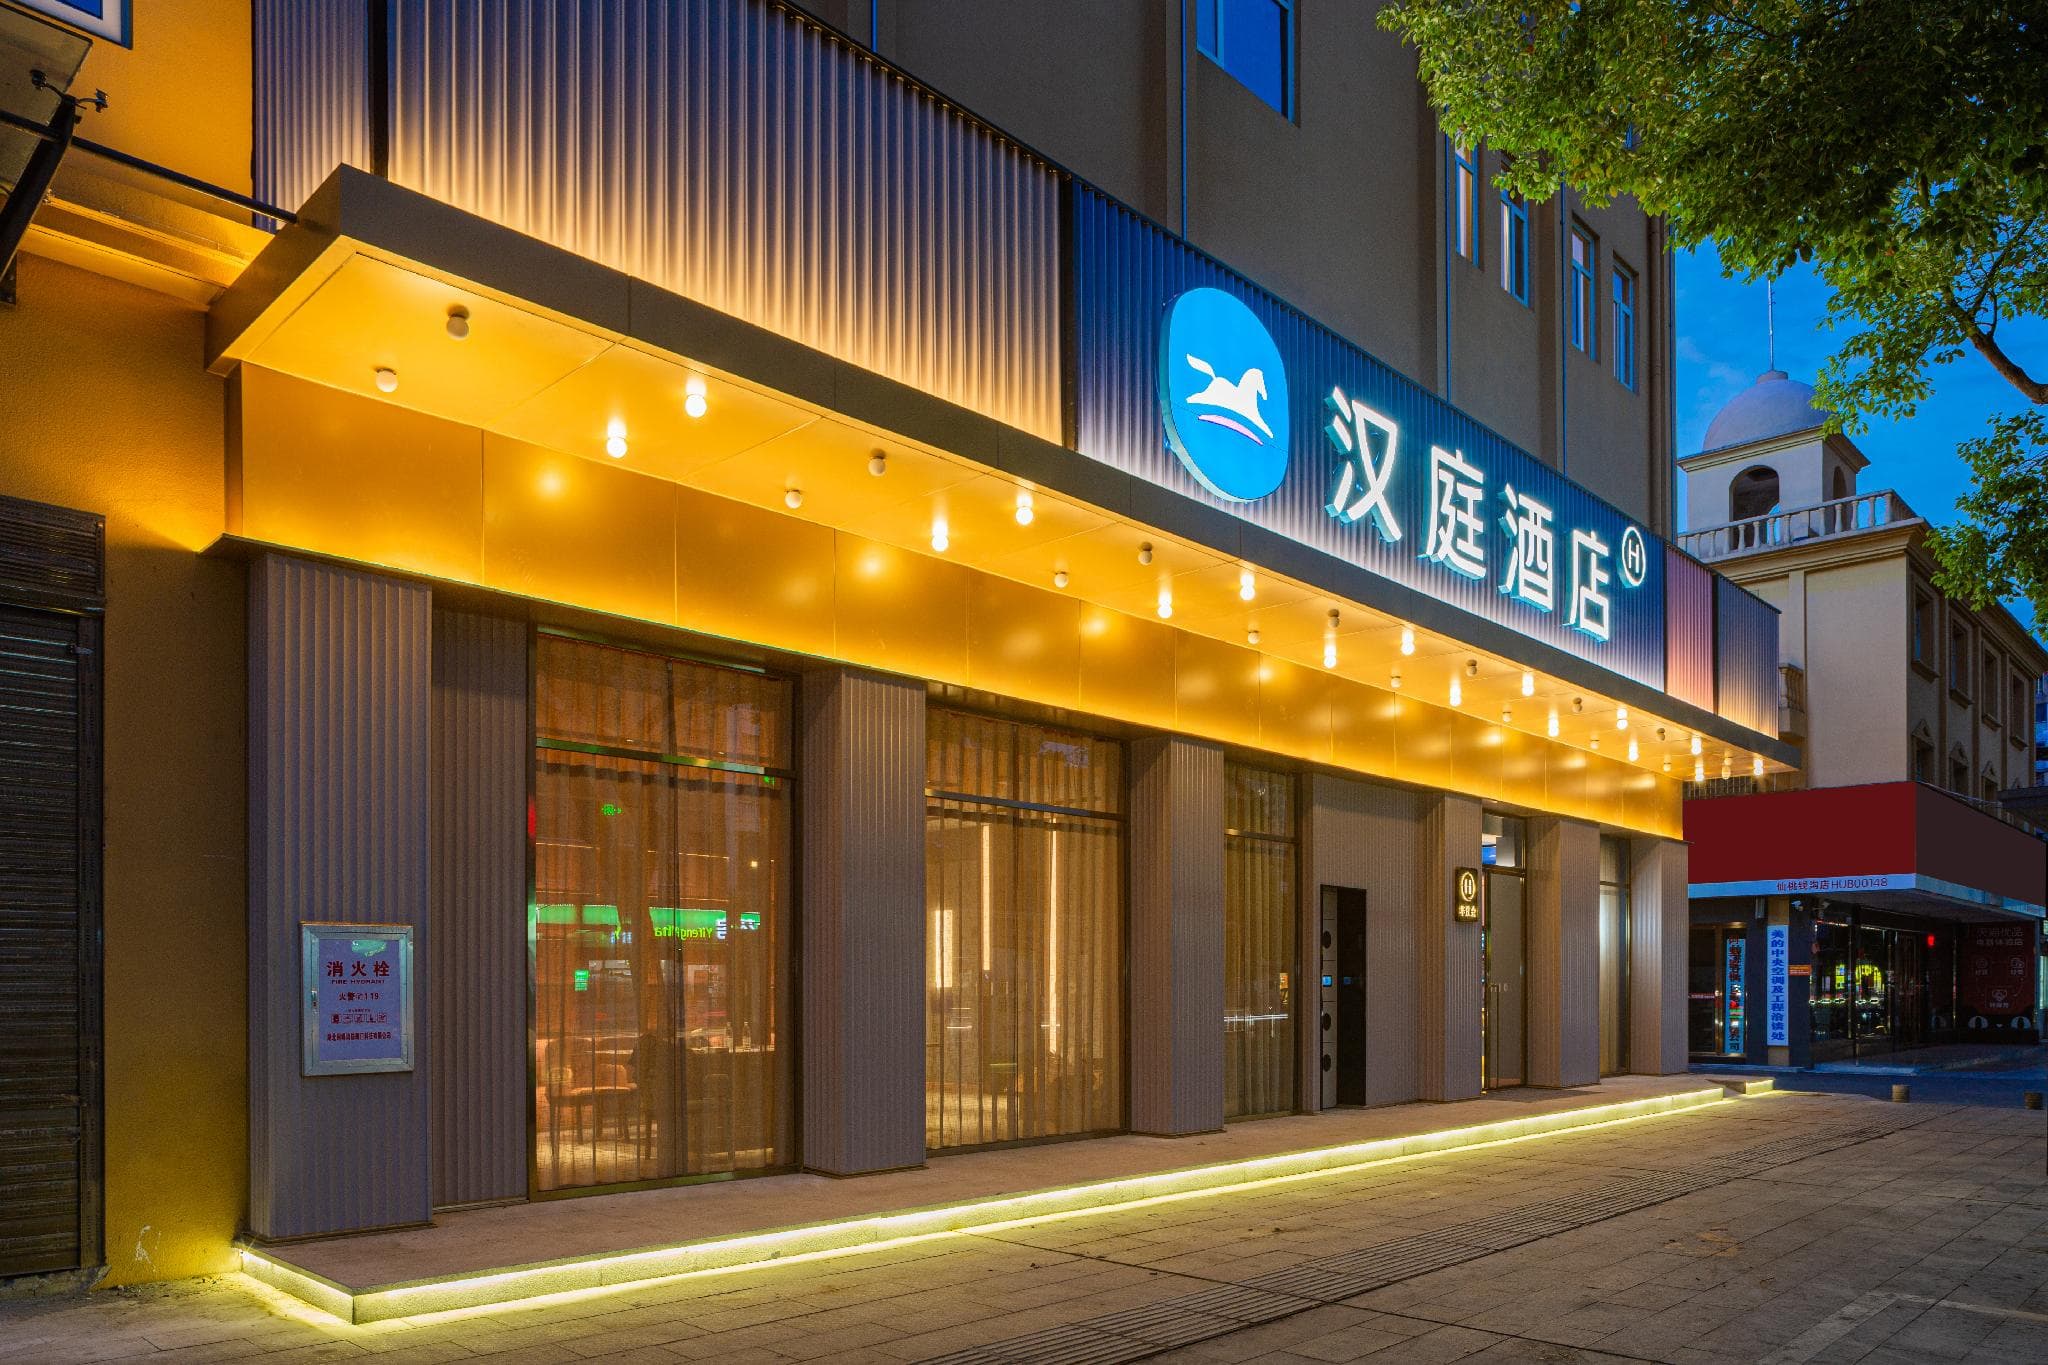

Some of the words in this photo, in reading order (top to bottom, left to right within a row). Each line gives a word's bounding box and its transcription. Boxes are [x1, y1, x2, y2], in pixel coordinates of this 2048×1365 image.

[1325, 386, 1611, 643] 汉庭酒店
[327, 960, 390, 978] 消火栓
